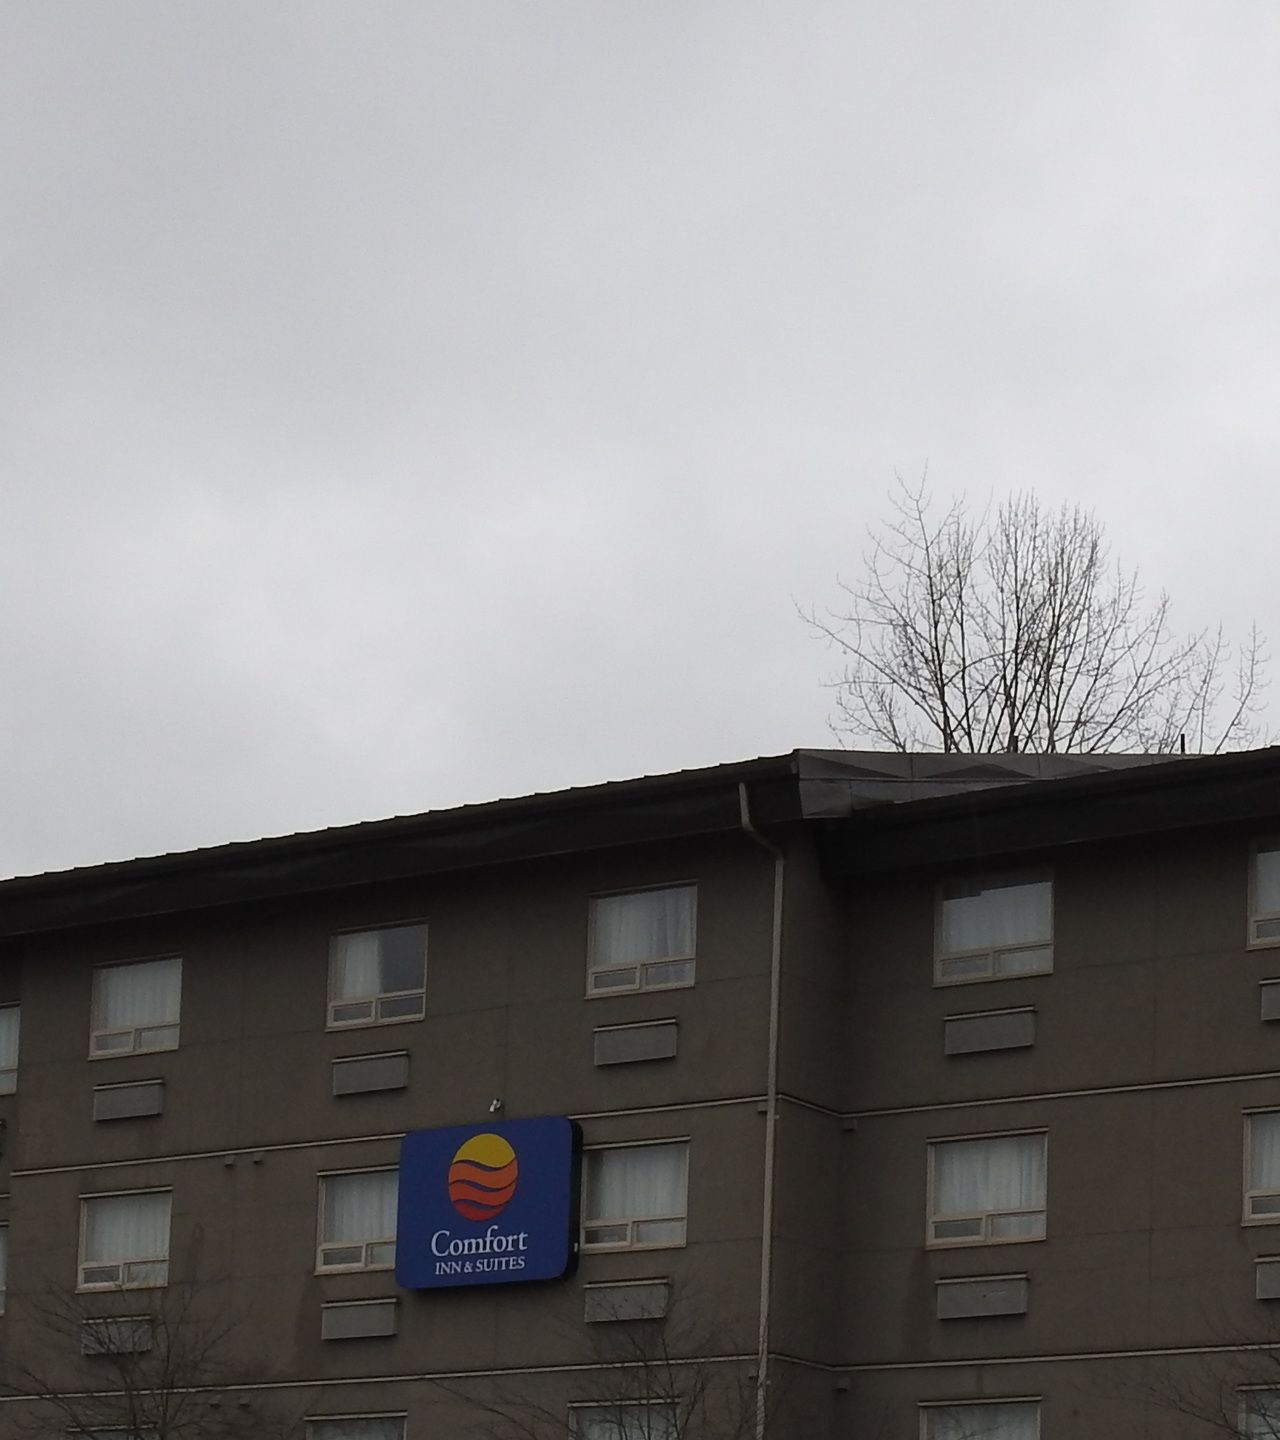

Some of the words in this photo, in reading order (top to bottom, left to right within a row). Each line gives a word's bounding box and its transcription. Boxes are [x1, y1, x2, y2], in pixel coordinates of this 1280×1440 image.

[431, 1225, 528, 1256] Comfort
[435, 1261, 461, 1275] INN
[464, 1261, 473, 1273] &
[475, 1256, 525, 1272] SUITES
